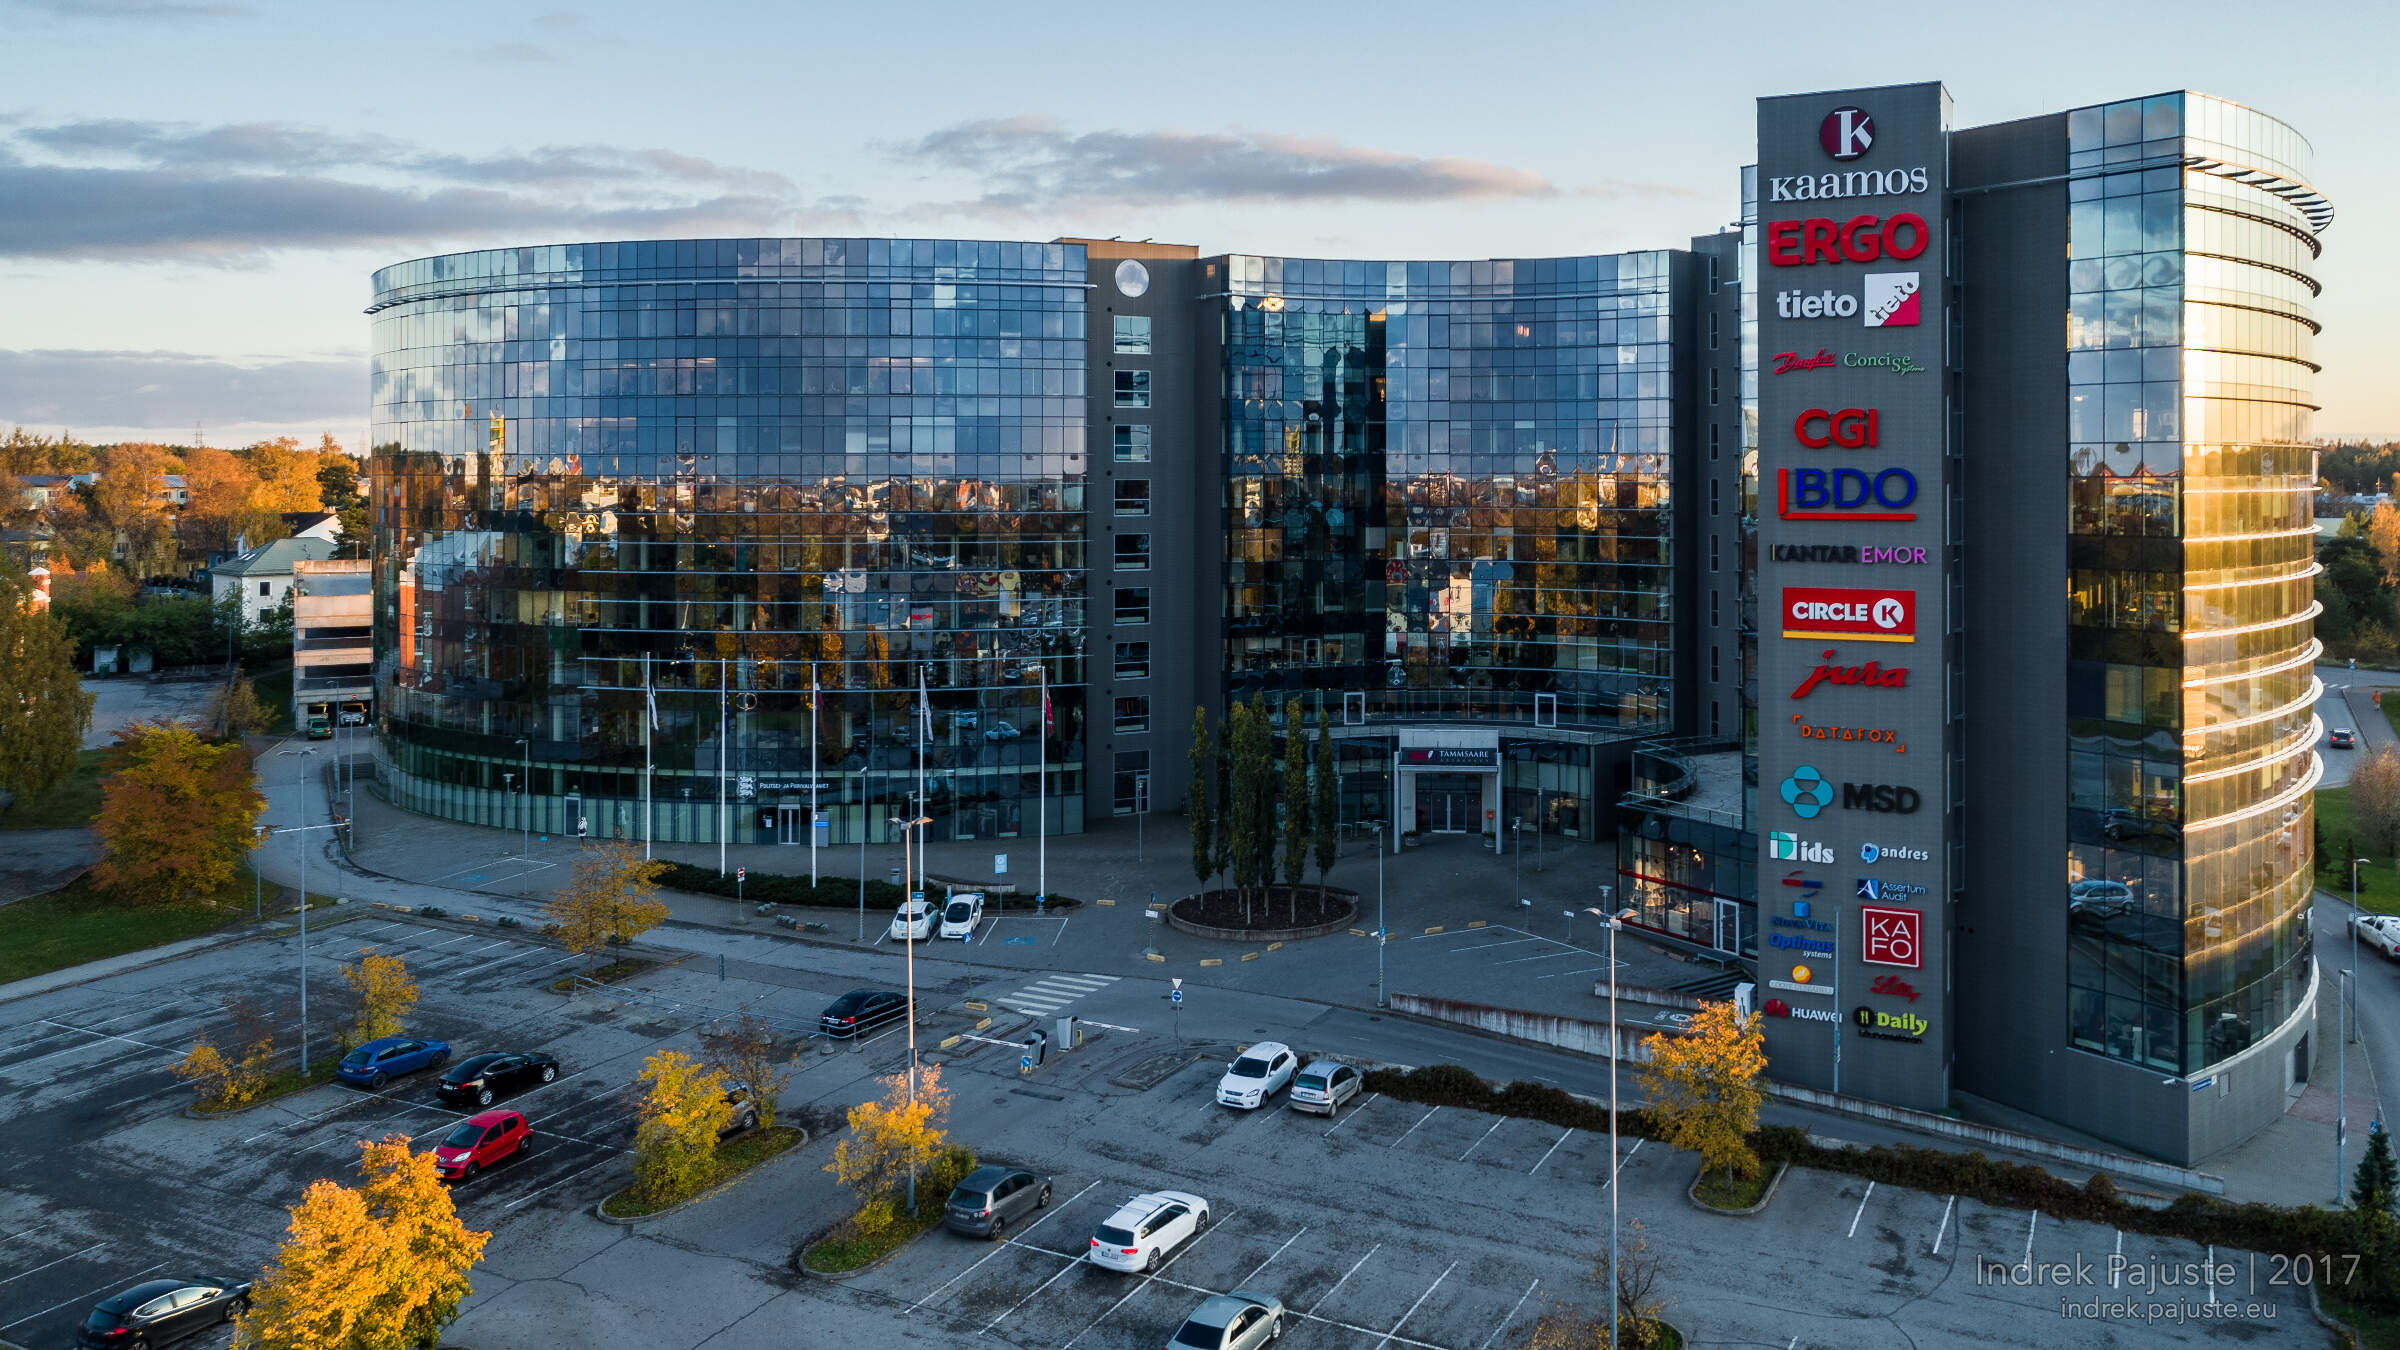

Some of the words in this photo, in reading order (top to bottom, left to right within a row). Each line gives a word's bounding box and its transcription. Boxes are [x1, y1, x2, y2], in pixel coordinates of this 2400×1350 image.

[1768, 212, 1929, 266] ERGO
[1777, 289, 1858, 318] tieto
[1794, 408, 1879, 448] CGI
[1795, 467, 1918, 509] BDO
[1769, 543, 1859, 563] KANTAR
[1861, 545, 1928, 565] EMOR
[1792, 601, 1868, 622] CIRCLE
[1877, 602, 1902, 626] K
[1790, 649, 1909, 700] jura
[1801, 724, 1896, 743] DATAFOX
[1843, 782, 1920, 814] MSD
[1801, 840, 1835, 864] ids
[1881, 846, 1928, 860] andres
[1881, 891, 1907, 901] Audit
[1769, 932, 1834, 952] Optimus
[1802, 950, 1832, 959] systems
[1877, 1011, 1928, 1036] Daily
